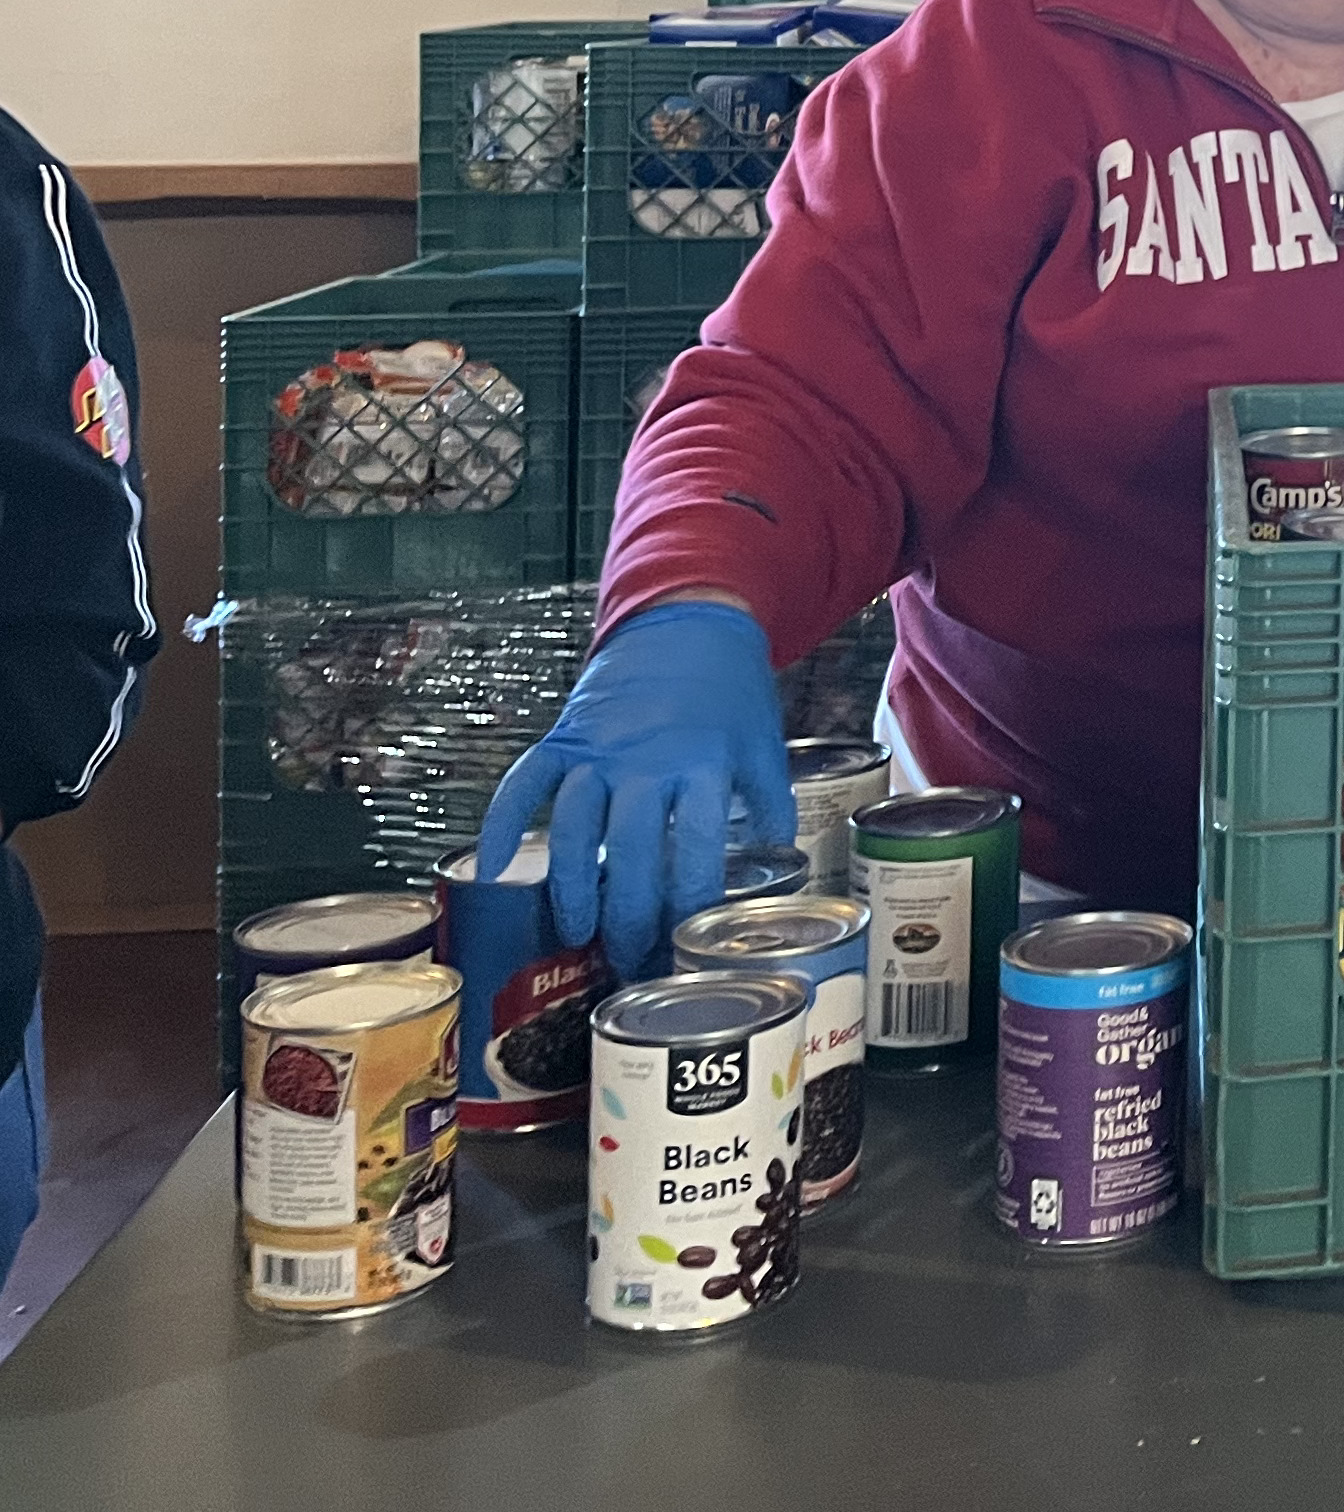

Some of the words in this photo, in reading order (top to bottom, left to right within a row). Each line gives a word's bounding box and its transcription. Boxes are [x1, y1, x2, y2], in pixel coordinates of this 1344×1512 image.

[1098, 129, 1338, 293] SANTA
[673, 1052, 742, 1093] 365
[1093, 1088, 1162, 1123] refried
[1093, 1113, 1149, 1143] black
[663, 1135, 751, 1171] Black
[1092, 1134, 1153, 1162] beans
[658, 1173, 753, 1205] Beans
